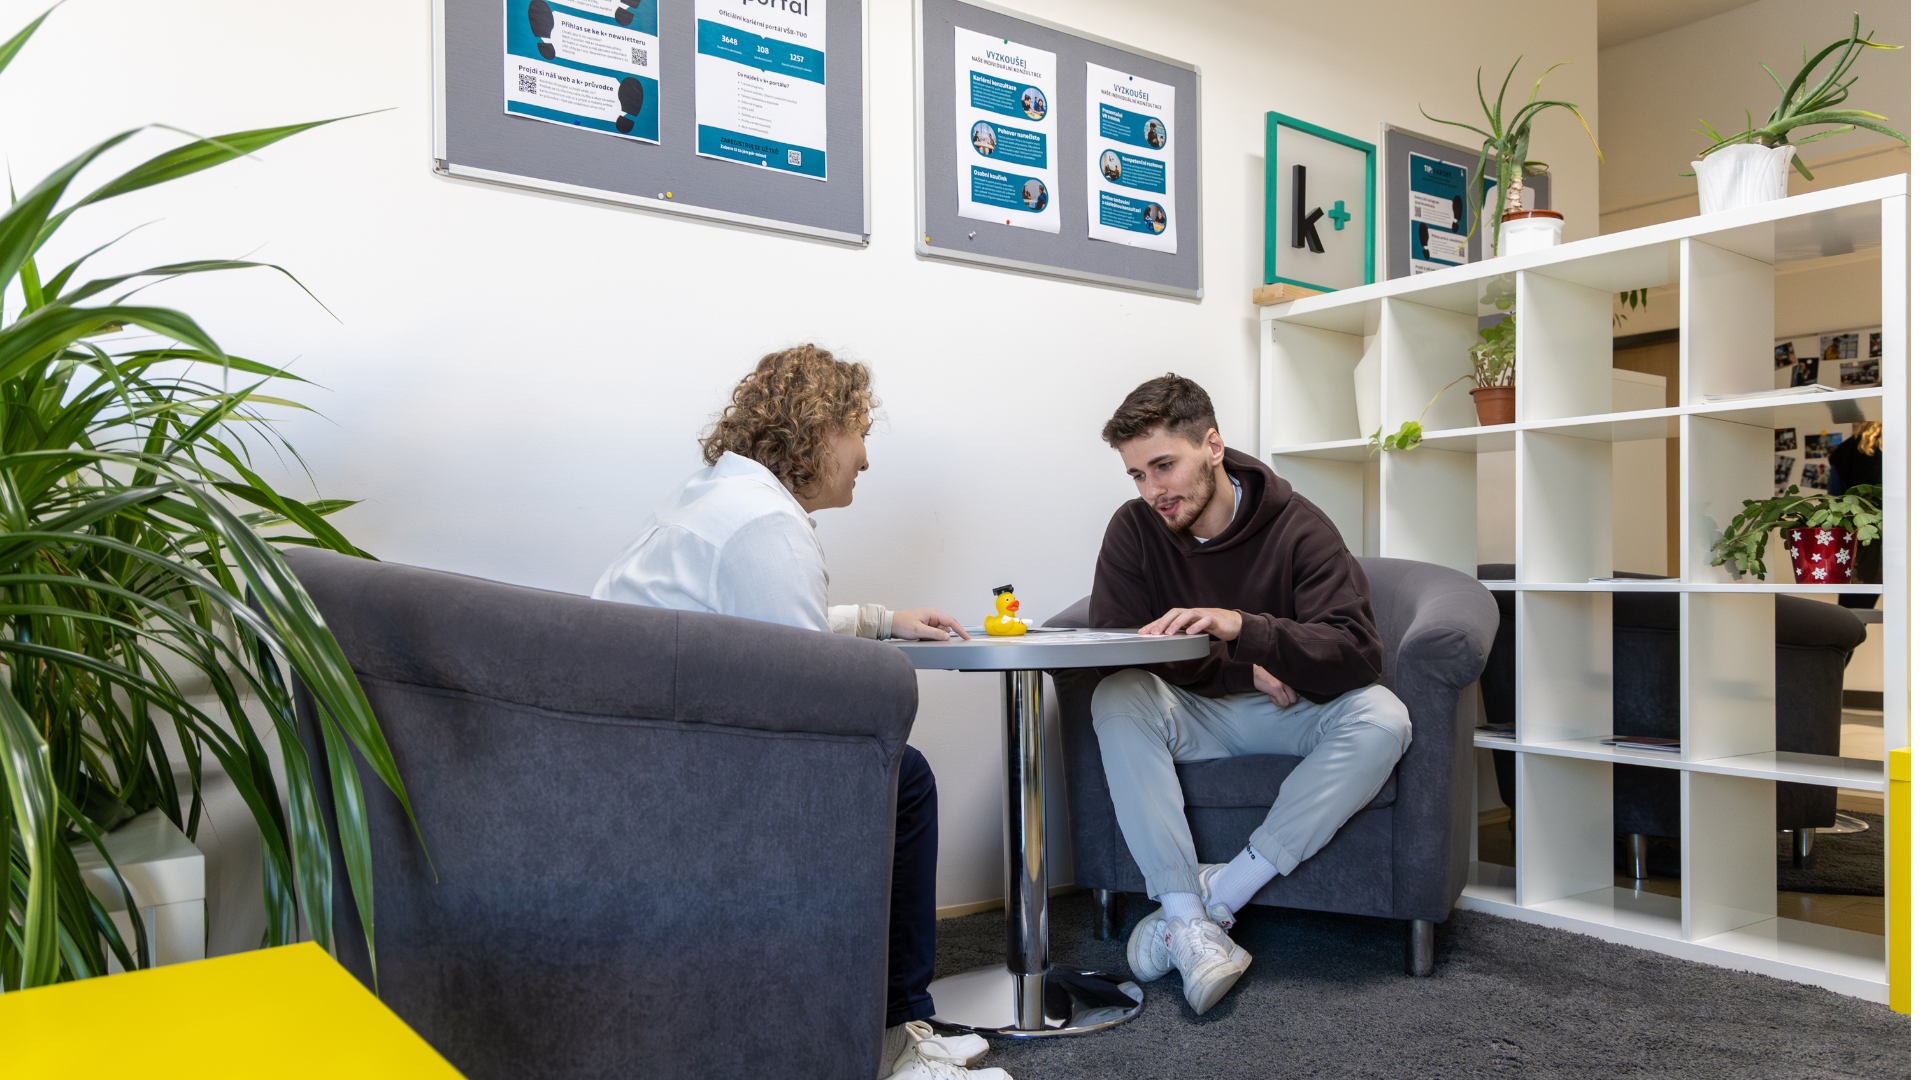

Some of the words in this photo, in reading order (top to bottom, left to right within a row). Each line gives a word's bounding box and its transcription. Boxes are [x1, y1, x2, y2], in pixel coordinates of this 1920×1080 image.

[719, 10, 742, 21] Oficiální
[743, 17, 764, 28] kariérní
[766, 23, 782, 33] portál
[561, 20, 583, 32] Přihlas
[609, 33, 646, 46] newsletteru
[721, 35, 738, 45] 3648
[757, 45, 769, 54] 108
[790, 53, 804, 63] 1257
[986, 50, 1026, 69] VYZKOUŠEJ
[984, 60, 1012, 71] INDIVIDUÁLNÍ
[1014, 68, 1041, 78] KONZULTACE
[518, 65, 538, 74] Projdi
[546, 70, 556, 79] náš
[558, 74, 570, 82] web
[576, 77, 583, 85] k+
[584, 80, 614, 92] průvodce
[744, 74, 759, 82] najdeš
[973, 74, 991, 84] Kariérní
[992, 80, 1016, 91] konzultace
[1114, 84, 1149, 101] VYZKOUŠEJ
[1137, 100, 1162, 110] KONZULTACE
[998, 127, 1017, 137] Pohovor
[1017, 132, 1040, 141] nanečisto
[720, 137, 754, 150] ZAREGISTRUJ
[974, 170, 989, 178] Osobní
[990, 172, 1007, 182] koučink
[1291, 164, 1351, 254] k+
